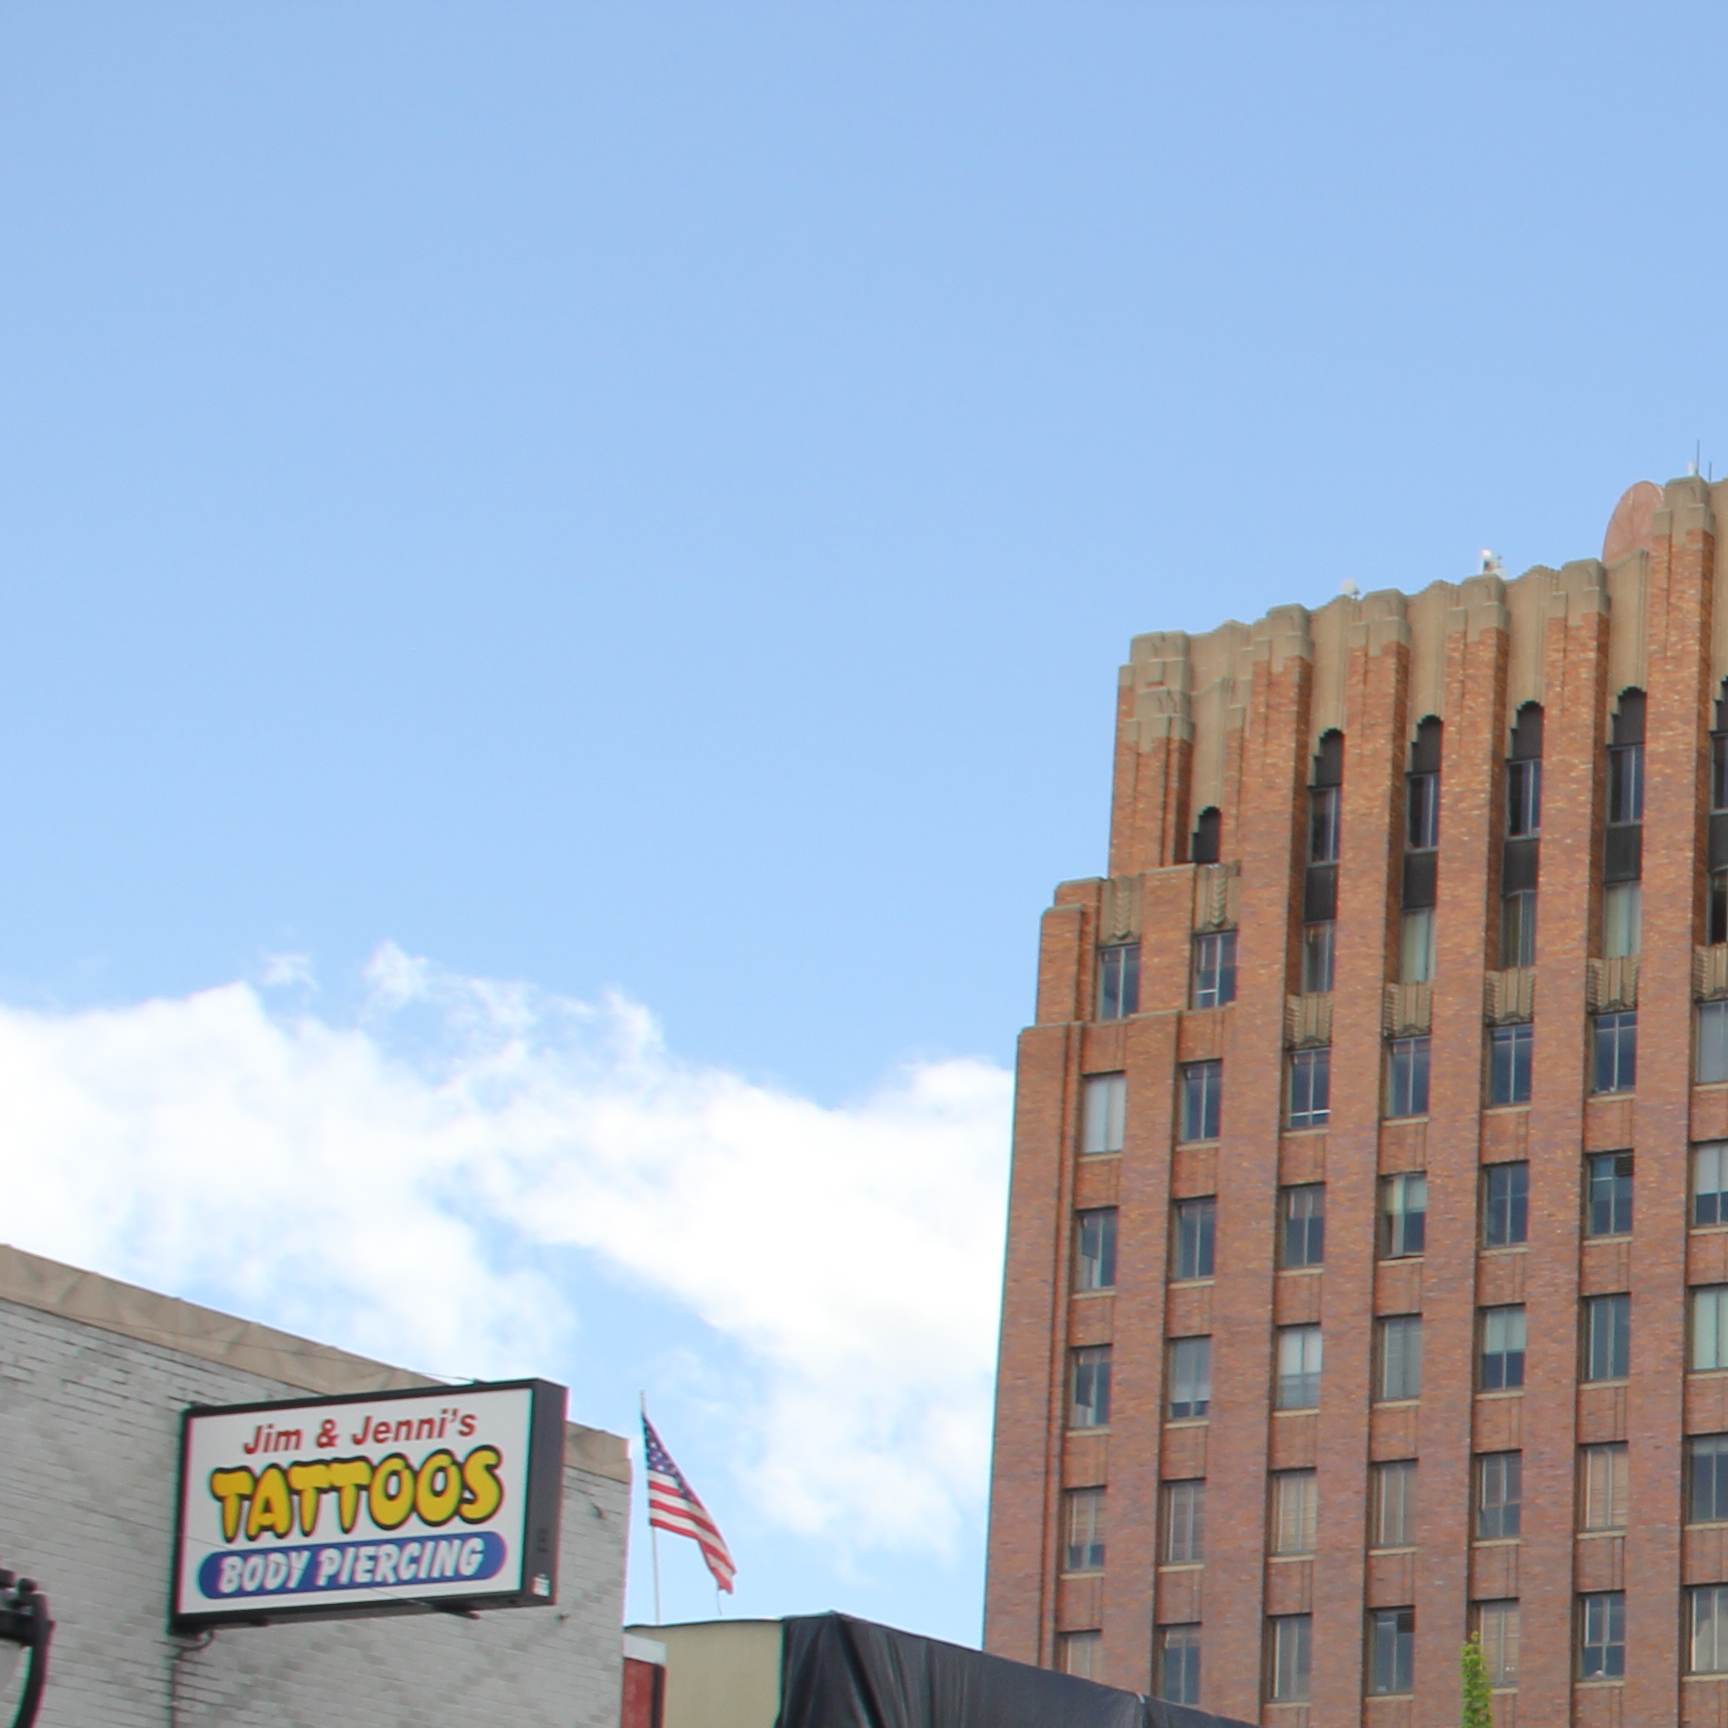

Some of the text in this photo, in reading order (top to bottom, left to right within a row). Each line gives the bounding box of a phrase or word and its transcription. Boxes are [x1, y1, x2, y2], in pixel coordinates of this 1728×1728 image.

[244, 1409, 478, 1455] Jim & Jenni's
[210, 1445, 504, 1544] TATTOOS
[217, 1536, 486, 1594] BODY PIERCING
